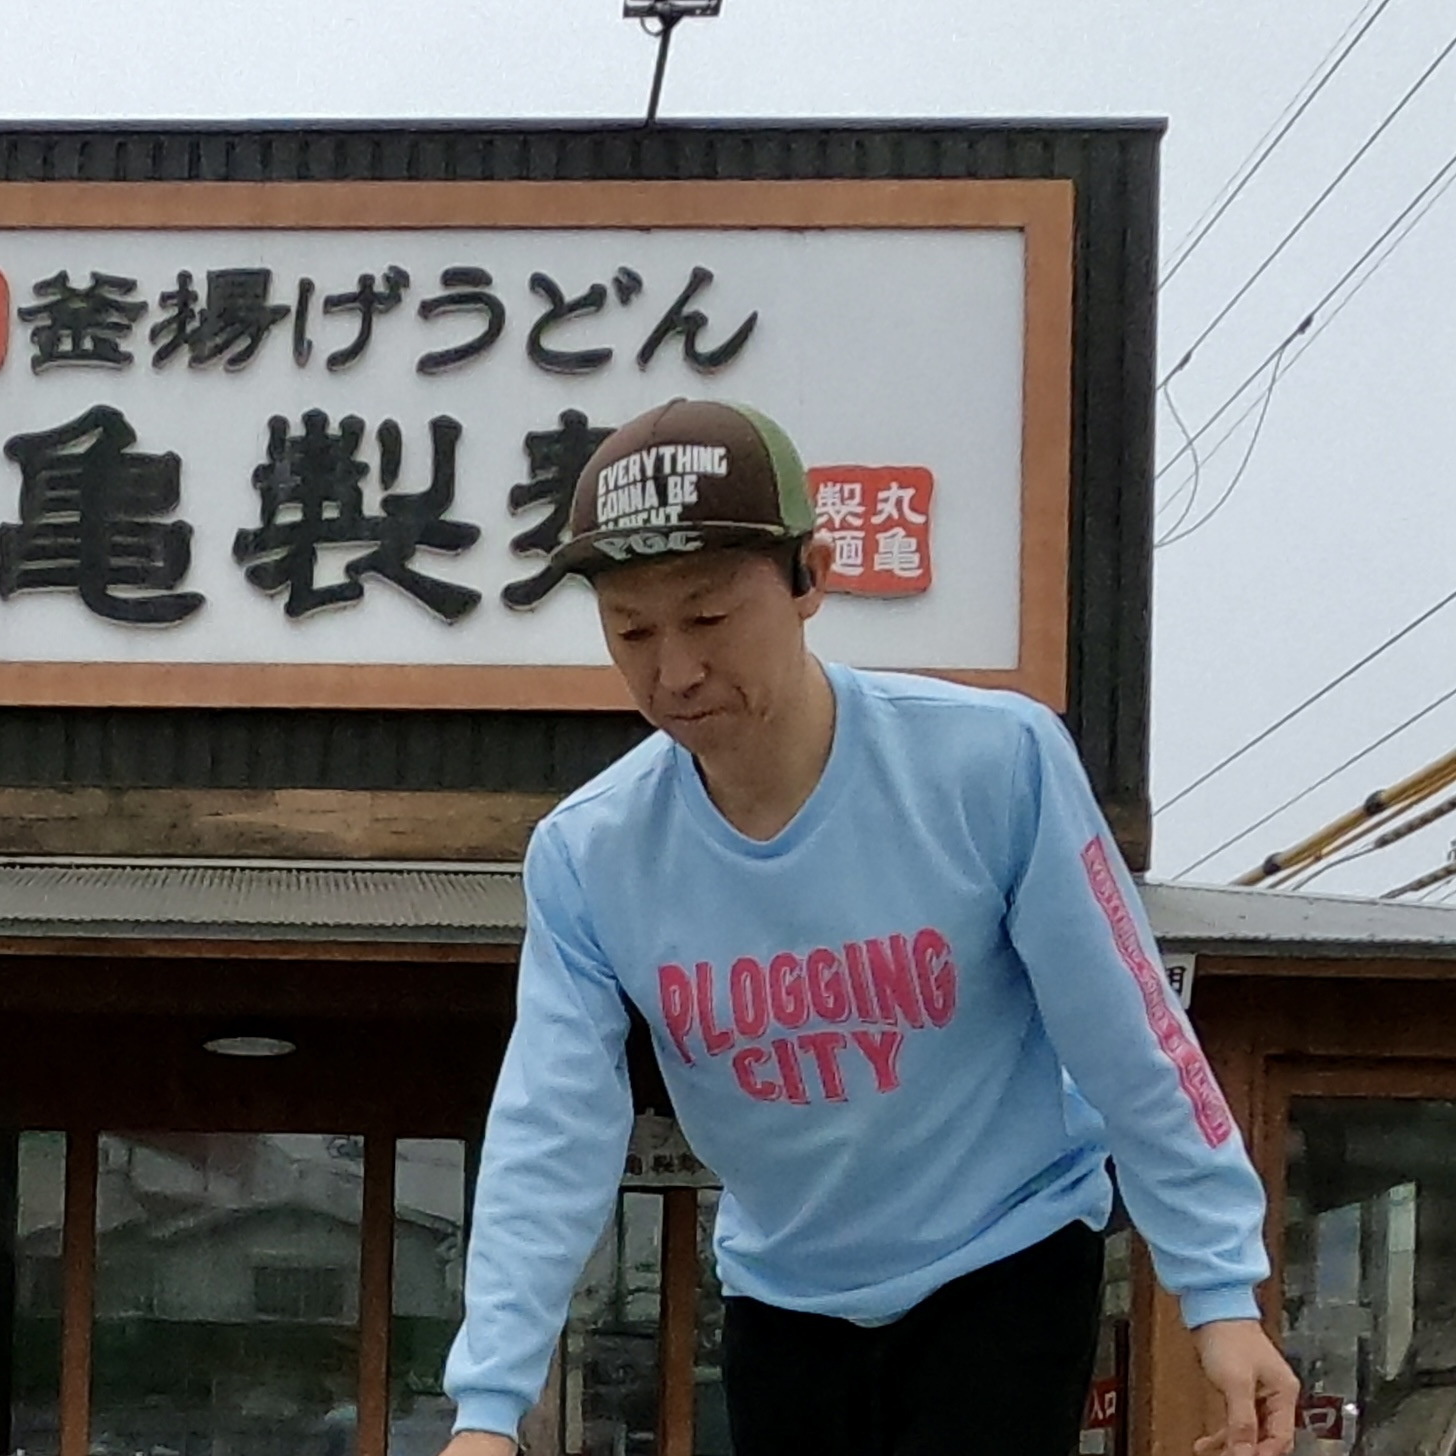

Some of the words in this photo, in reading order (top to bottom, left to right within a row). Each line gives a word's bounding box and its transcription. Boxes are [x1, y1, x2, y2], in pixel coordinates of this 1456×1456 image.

[18, 266, 760, 376] 釜揚げうどん
[597, 480, 659, 524] GONNA
[667, 474, 699, 506] BE
[598, 445, 729, 497] EVERYTHING
[657, 926, 959, 1067] PLOGGING
[731, 1027, 905, 1107] CITY
